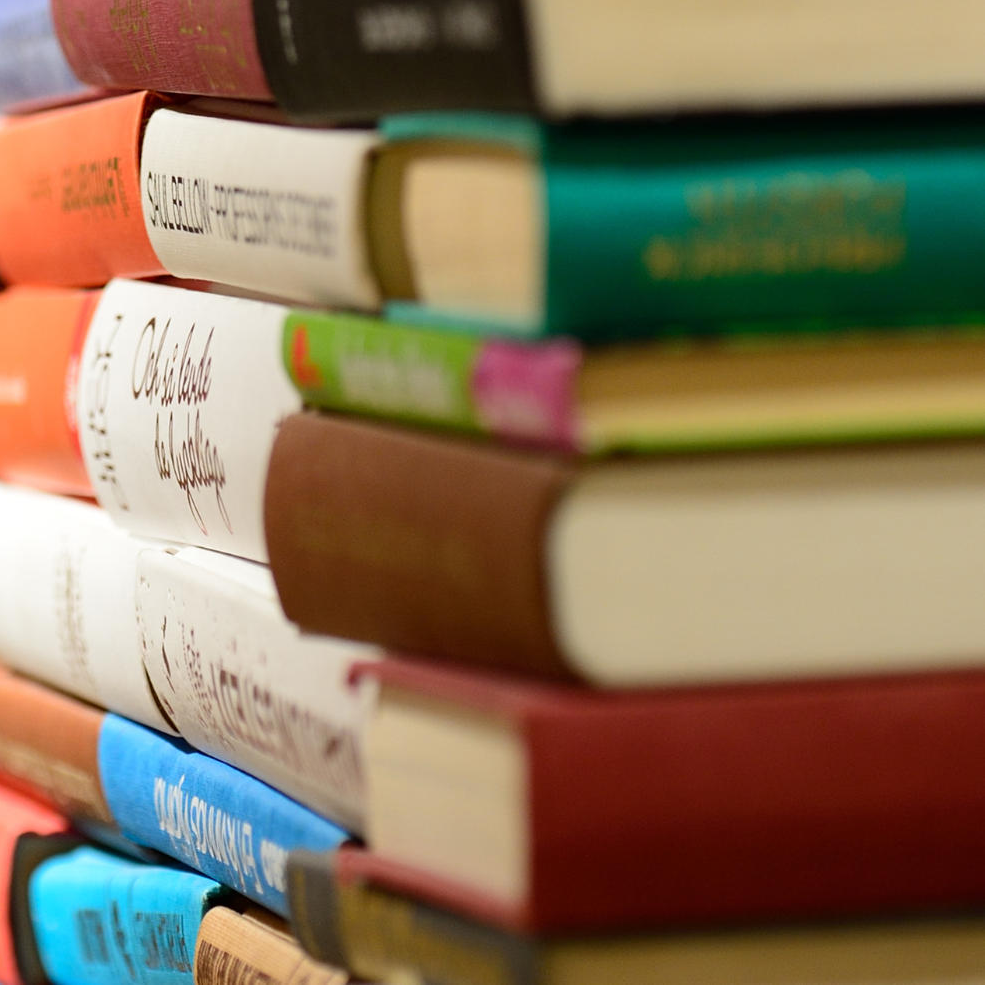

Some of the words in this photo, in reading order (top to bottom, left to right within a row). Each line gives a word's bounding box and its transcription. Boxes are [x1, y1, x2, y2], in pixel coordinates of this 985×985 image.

[147, 170, 174, 230] SAUL
[171, 175, 212, 235] BELLOW
[131, 316, 172, 405] Och
[160, 342, 179, 407] så
[177, 322, 216, 406] levde
[154, 412, 171, 480] de
